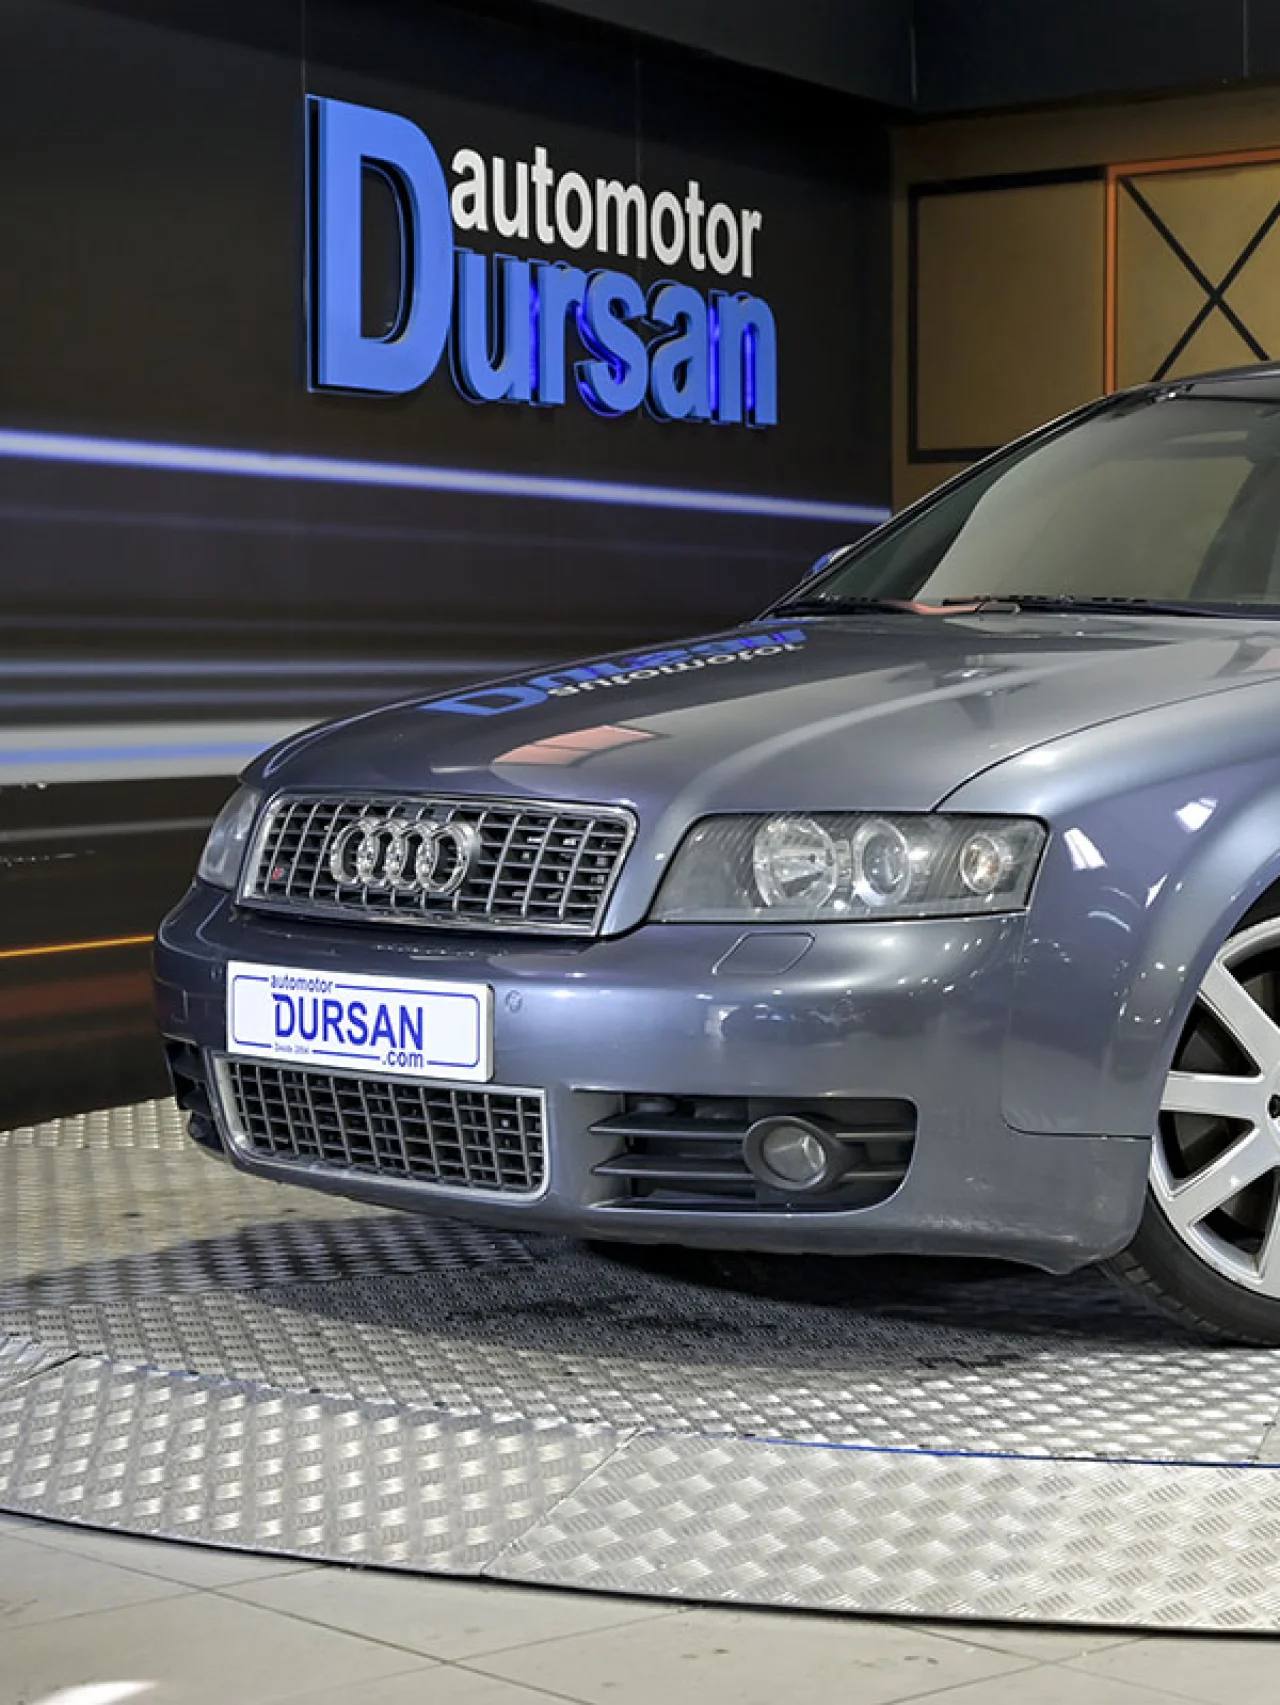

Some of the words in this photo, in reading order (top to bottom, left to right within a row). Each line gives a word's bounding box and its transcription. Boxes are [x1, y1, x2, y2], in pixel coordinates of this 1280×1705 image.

[451, 147, 762, 277] automotor
[306, 93, 778, 428] Dursan
[270, 974, 333, 993] automotor
[272, 993, 423, 1051] DURSAN
[381, 1049, 424, 1068] .com
